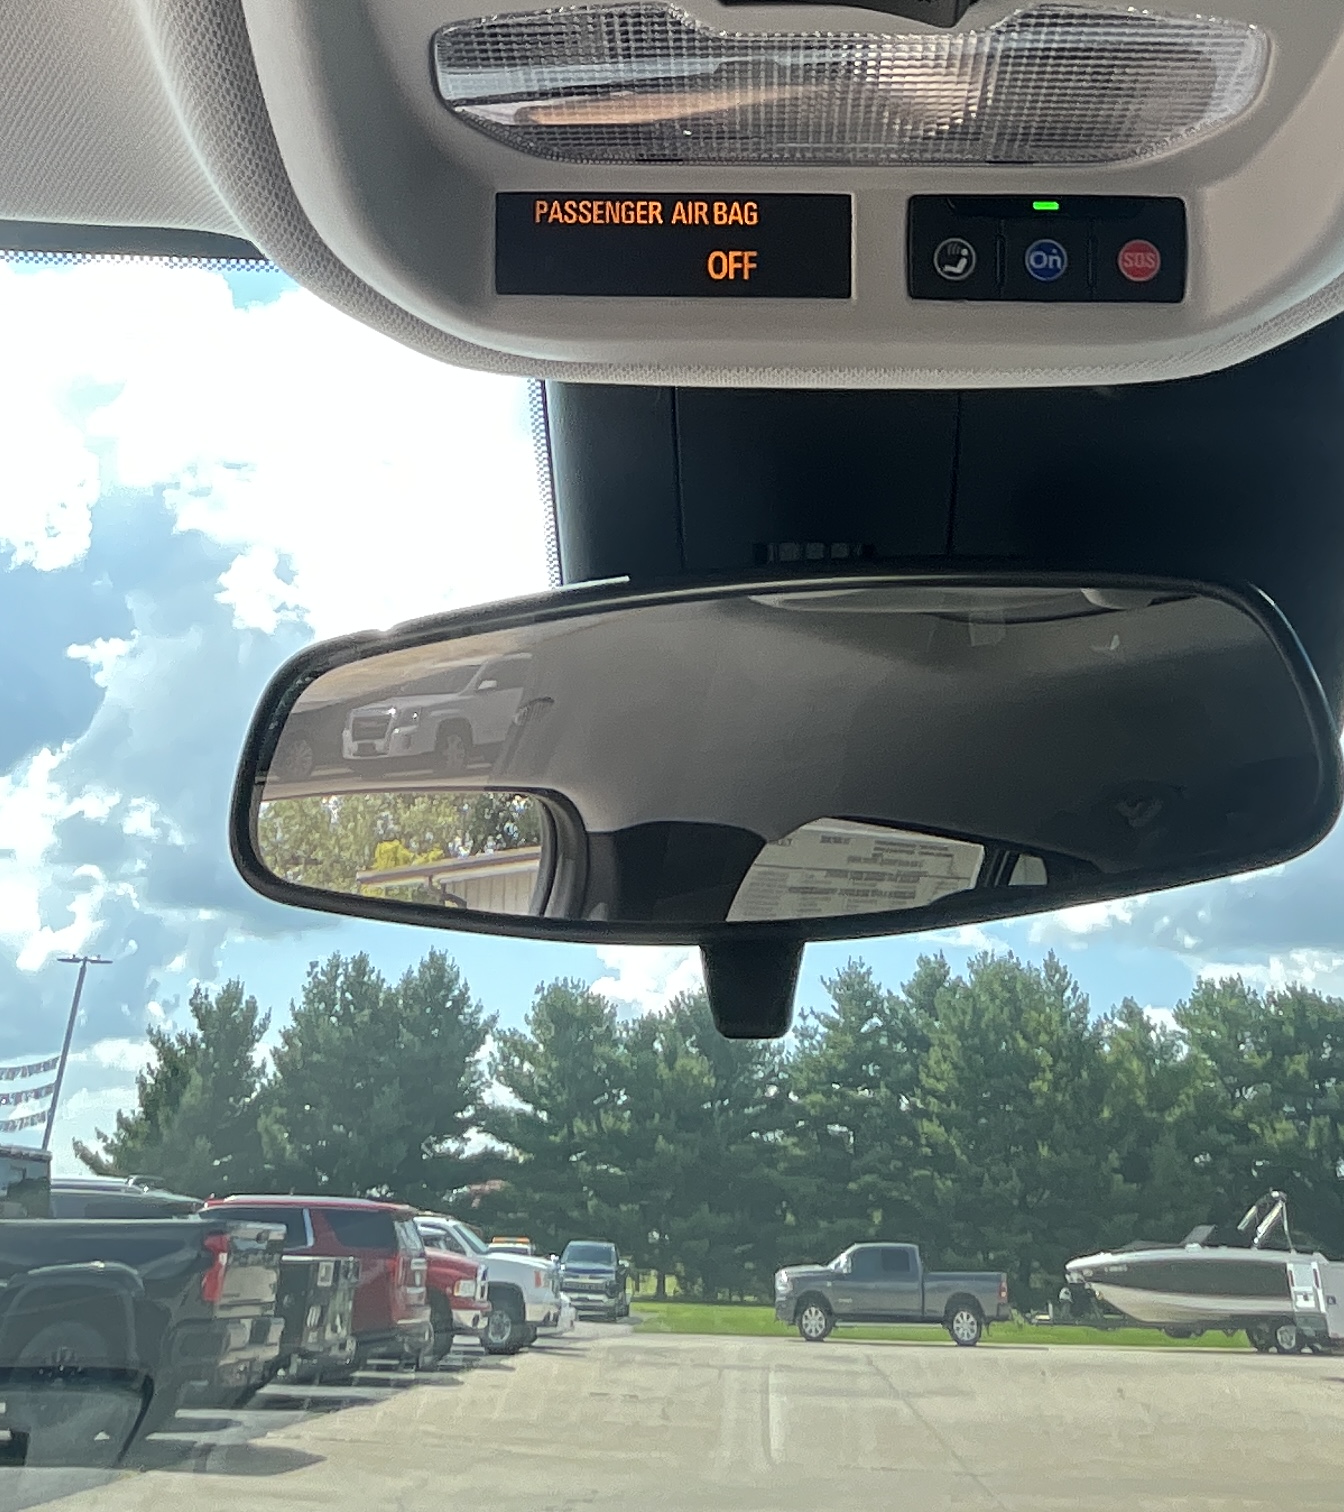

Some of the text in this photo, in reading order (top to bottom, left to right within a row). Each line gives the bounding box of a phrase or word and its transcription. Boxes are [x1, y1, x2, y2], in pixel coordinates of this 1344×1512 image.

[534, 199, 759, 226] PASSENGER AIR BAG
[706, 250, 759, 281] OFF
[1122, 251, 1156, 270] SOS
